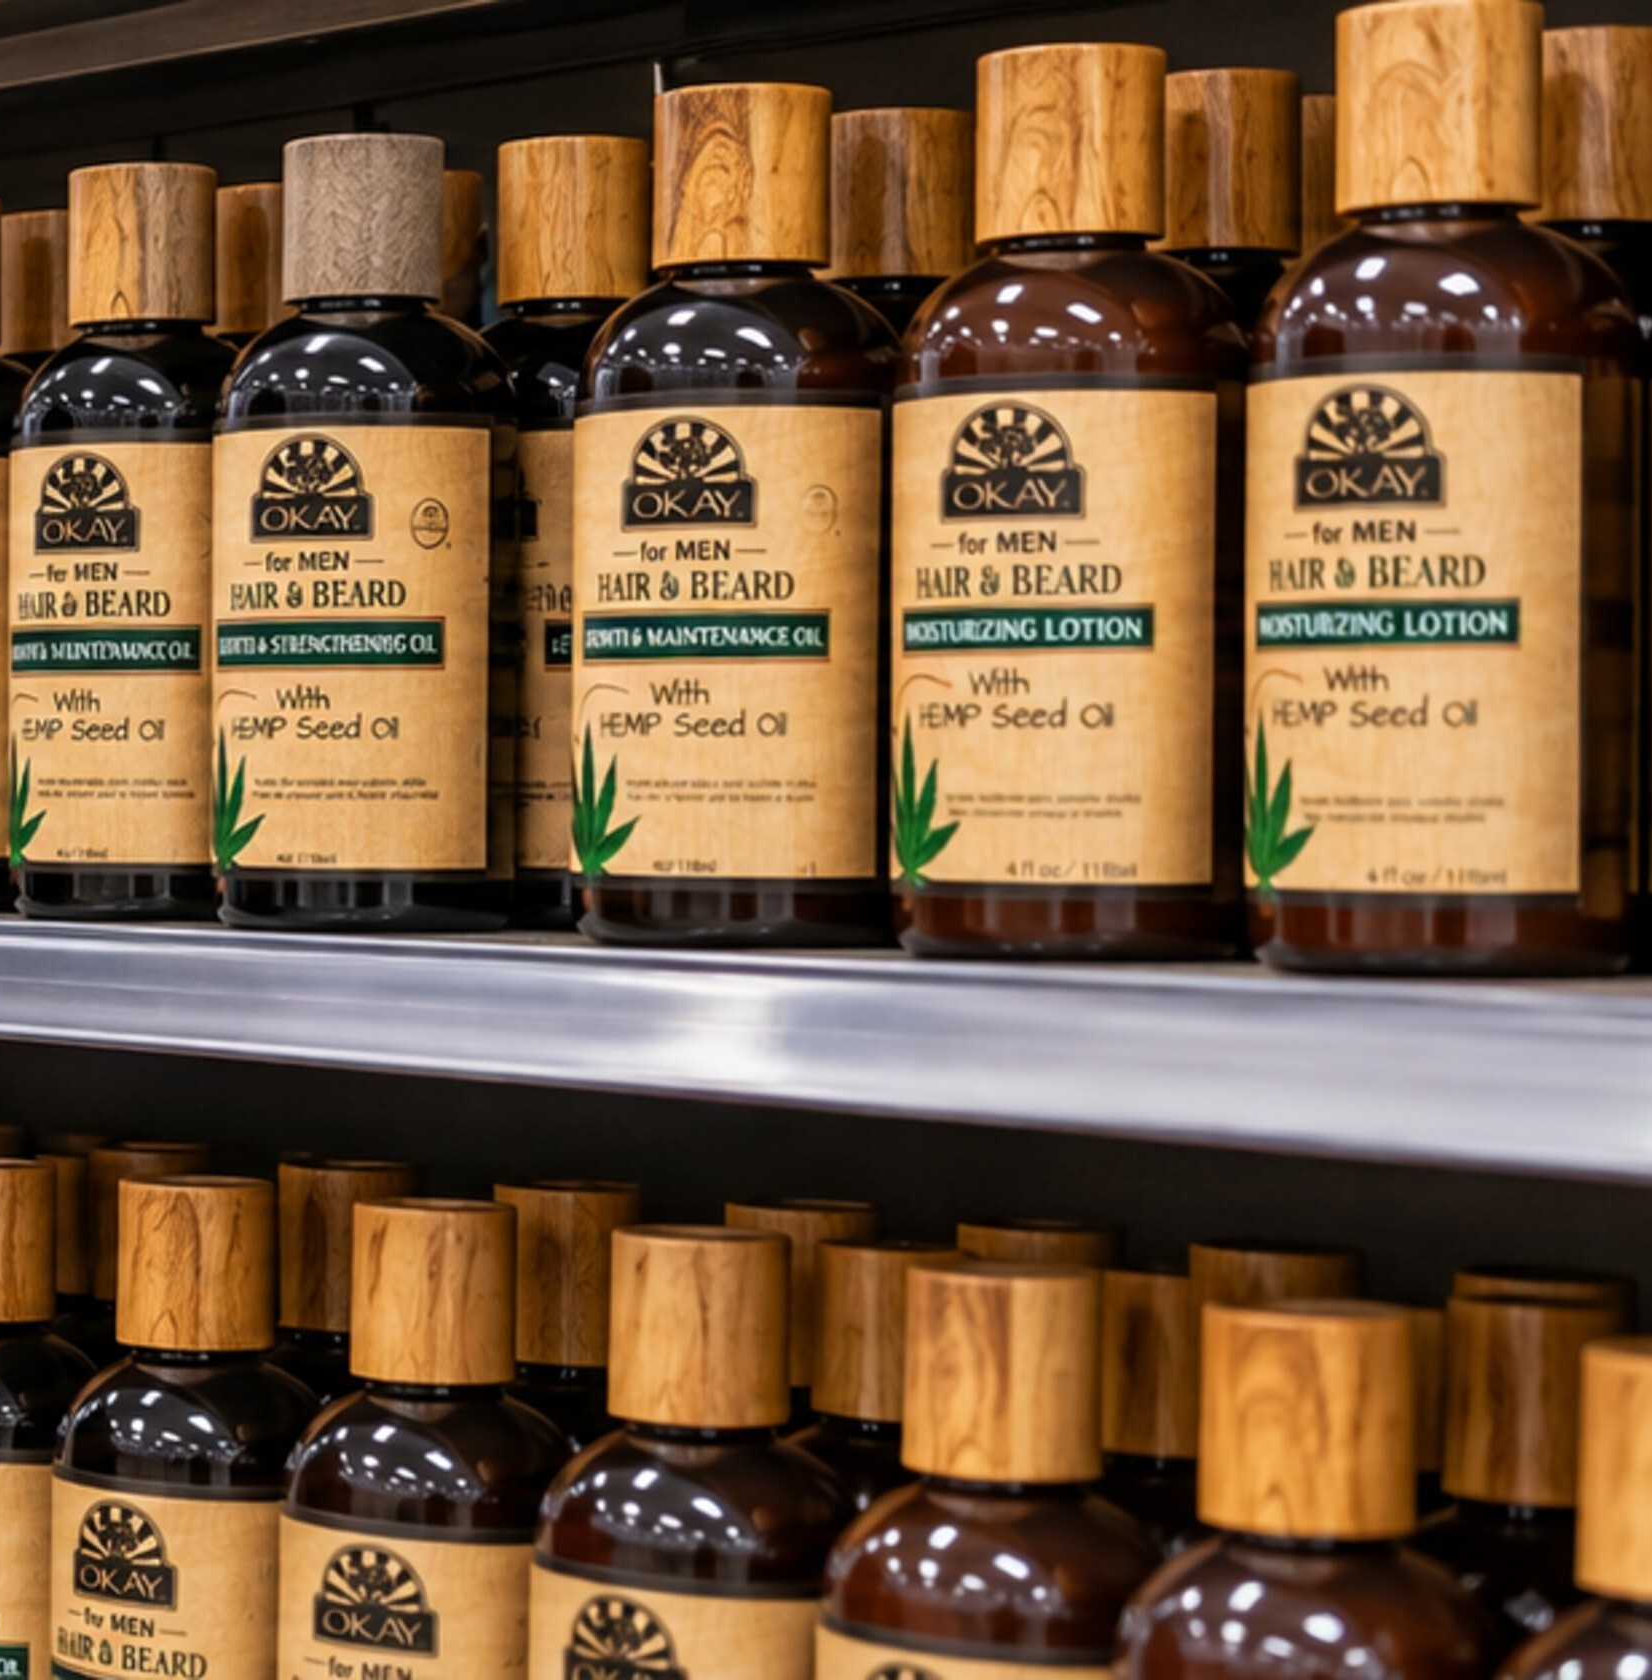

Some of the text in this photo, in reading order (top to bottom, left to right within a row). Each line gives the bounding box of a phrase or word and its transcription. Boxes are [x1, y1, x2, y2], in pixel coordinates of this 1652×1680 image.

[954, 480, 1067, 510] OKAY
[1307, 466, 1423, 498] OKAY
[260, 503, 357, 531] OKAY
[632, 489, 737, 520] OKAY
[41, 517, 126, 544] OKAY
[958, 530, 1057, 556] for MEN
[1312, 519, 1417, 545] for MEN
[265, 551, 350, 573] for MEN
[640, 539, 731, 563] for MEN
[74, 563, 118, 582] MEN
[597, 570, 795, 603] HAIR & BEARD
[916, 563, 1122, 600] HAIR & BEARD
[1269, 554, 1487, 592] HAIR & BEARD
[85, 590, 171, 617] BEARD
[231, 579, 407, 611] HAIR & BEARD
[1045, 617, 1143, 642] LOTION
[1403, 609, 1509, 637] LOTION
[650, 678, 711, 706] With
[968, 667, 1031, 696] With
[1323, 663, 1390, 693] With
[53, 688, 101, 713] With
[276, 684, 331, 710] With
[1272, 693, 1477, 728] HEMP Seed Oil
[296, 712, 362, 740] Seed
[371, 715, 400, 739] Oil
[600, 708, 788, 738] HEMP Seed Oil
[919, 697, 1114, 729] HEMP Seed Oil
[71, 716, 130, 741] Seed
[138, 719, 166, 741] Oil
[79, 1563, 165, 1599] OKAY
[83, 1607, 155, 1638] for MEN
[322, 1609, 422, 1646] OKAY
[121, 1643, 208, 1679] BEARD
[328, 1655, 354, 1678] for
